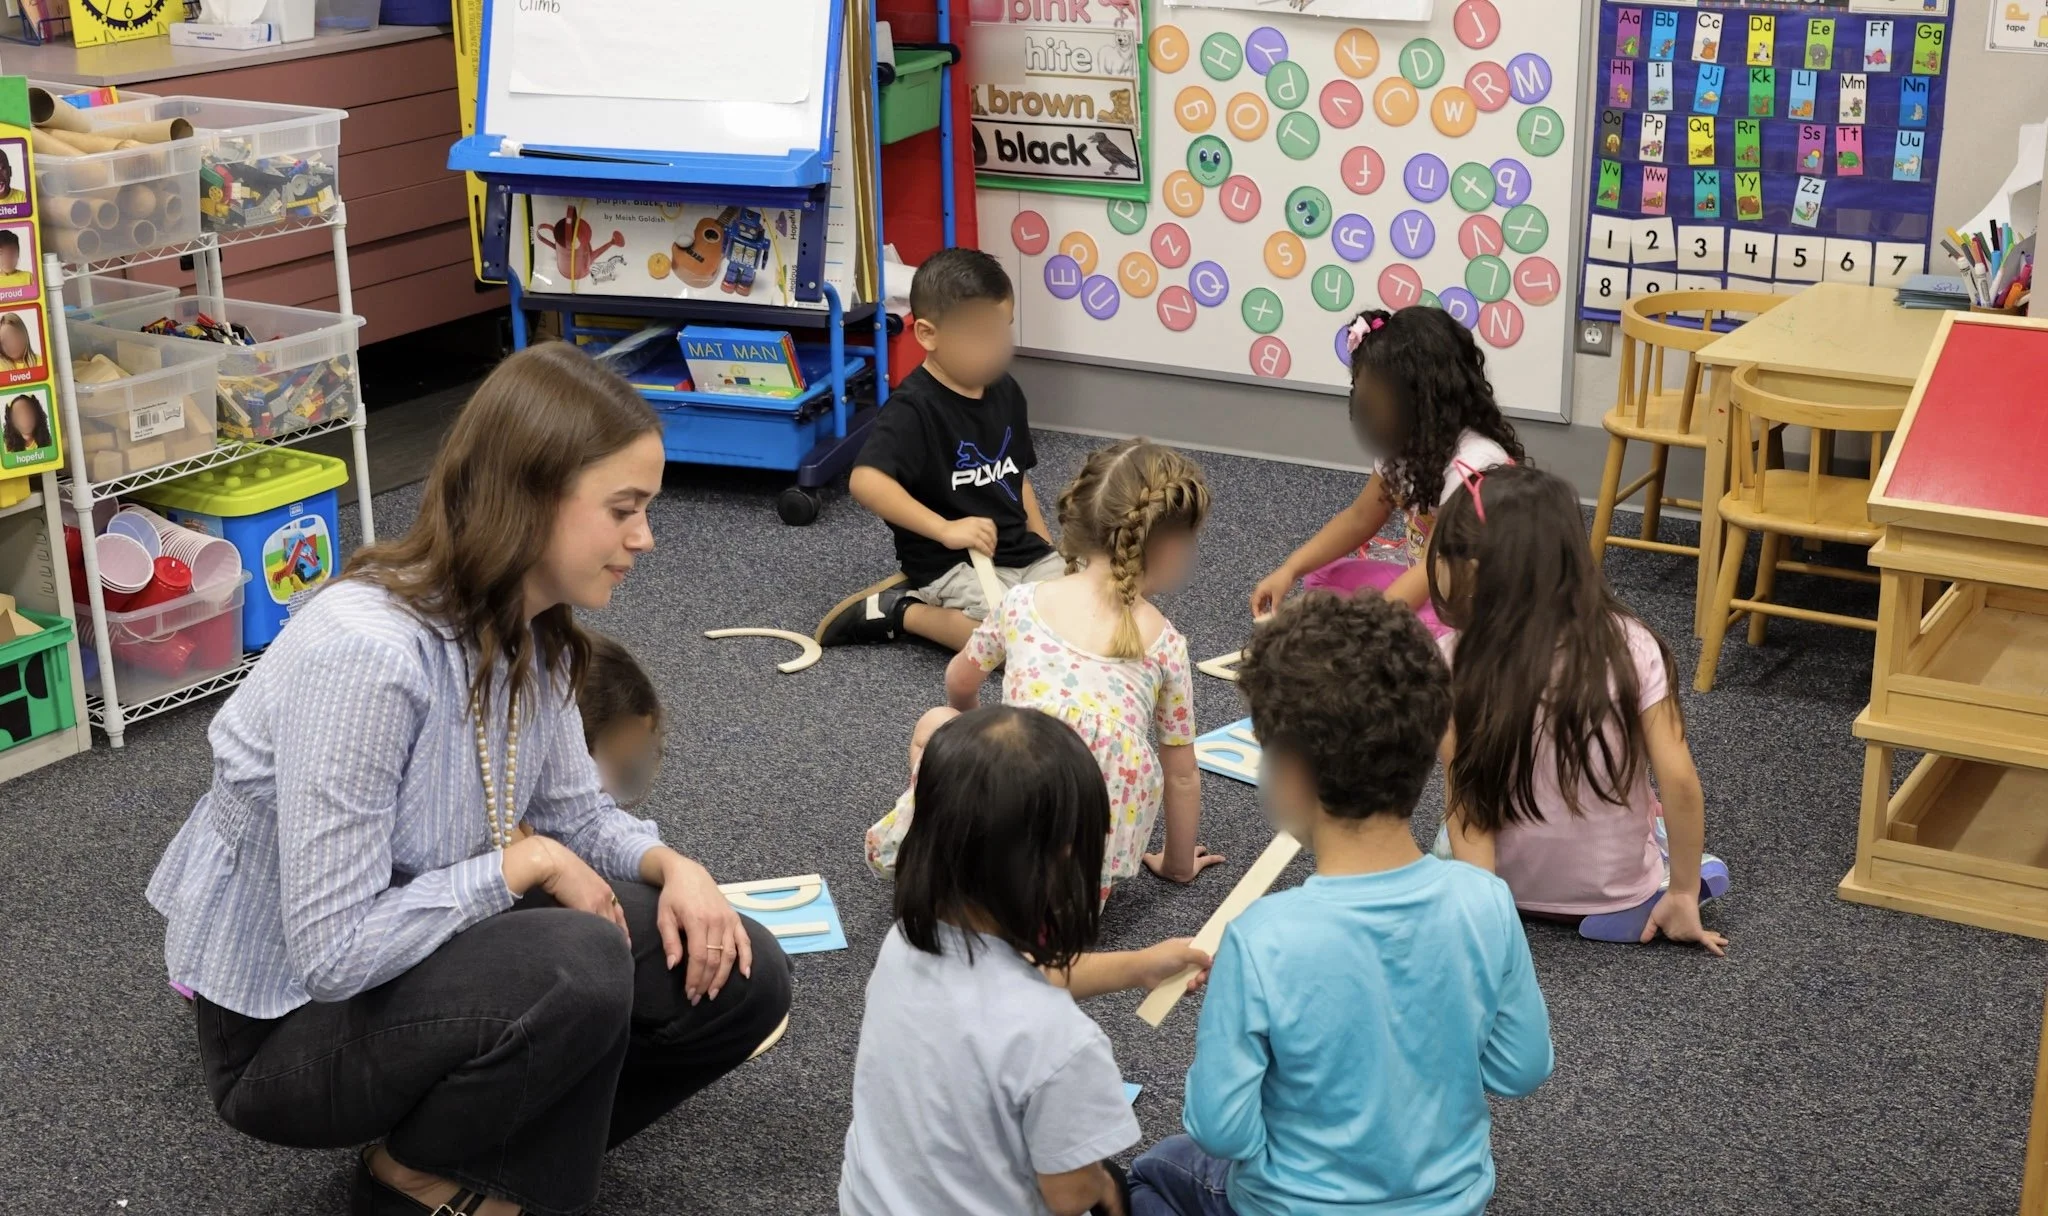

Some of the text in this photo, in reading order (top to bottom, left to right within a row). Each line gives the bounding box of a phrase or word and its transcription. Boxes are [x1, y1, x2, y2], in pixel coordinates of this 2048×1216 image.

[124, 1, 133, 19] 6
[1008, 0, 1092, 23] pink
[1468, 5, 1486, 43] j
[1620, 10, 1943, 45] Aa Bb Cc Dd Ee Ff Gg
[2006, 24, 2026, 32] tape
[1025, 36, 1093, 73] hite
[1207, 42, 1236, 70] H
[1411, 49, 1433, 80] D
[1472, 73, 1503, 103] R
[1514, 61, 1544, 97] M
[1613, 61, 1925, 92] Hh Ii Jj Kk Ll Mm Nn
[988, 84, 1094, 119] brown
[1283, 120, 1310, 144] T
[1603, 111, 1920, 147] Oo Pp Qq Rr Ss Tt Uu
[994, 129, 1091, 166] black
[1173, 178, 1193, 207] G
[1603, 161, 1819, 194] Vv Ww Xx Yy Zz
[604, 213, 613, 221] by
[638, 215, 666, 223] Goldish
[789, 209, 798, 240] Hopeful
[1404, 219, 1422, 249] A
[1646, 231, 1658, 249] 2
[1694, 238, 1706, 258] 3
[1745, 243, 1757, 263] 4
[1794, 248, 1806, 267] 5
[1841, 252, 1854, 271] 6
[1893, 256, 1907, 275] 7
[1051, 269, 1076, 285] E
[1197, 270, 1224, 297] Q
[1389, 274, 1414, 301] F
[1522, 271, 1552, 291] J
[1600, 278, 1611, 297] 8
[0, 289, 23, 300] proud
[1491, 307, 1511, 339] N
[687, 341, 779, 361] MAT MAN
[1261, 344, 1281, 374] B
[10, 371, 31, 382] loved
[16, 450, 45, 464] hopeful
[952, 456, 1019, 491] PUMA
